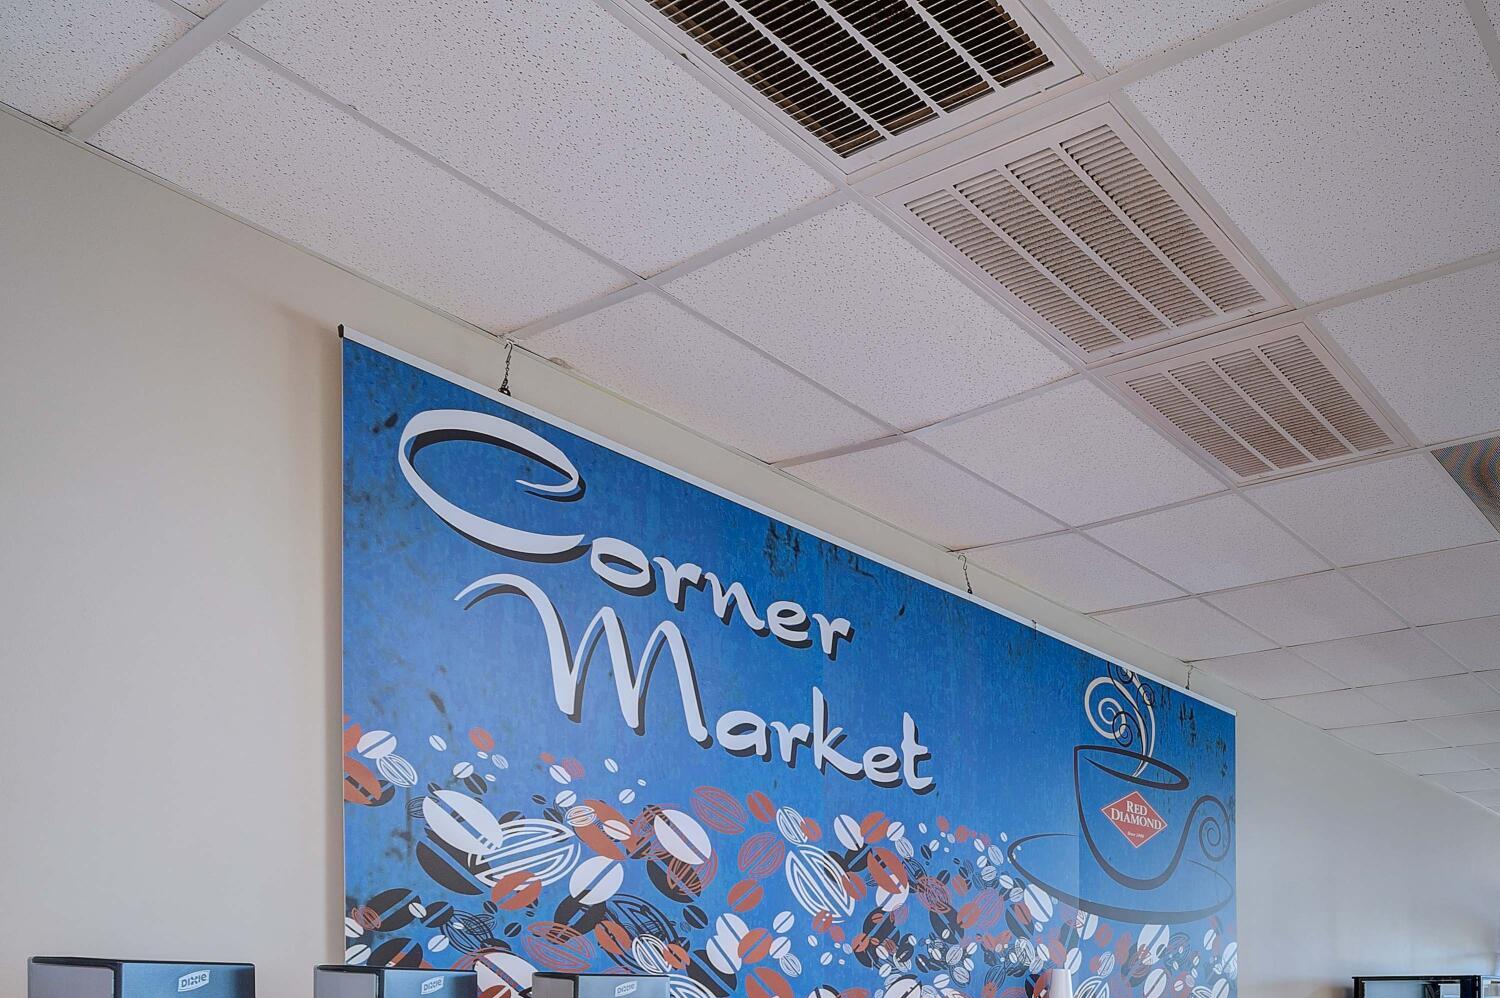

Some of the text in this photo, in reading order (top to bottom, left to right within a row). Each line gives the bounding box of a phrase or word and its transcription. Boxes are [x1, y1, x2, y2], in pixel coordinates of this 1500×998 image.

[398, 409, 853, 660] Corner
[454, 573, 936, 793] Market
[1111, 808, 1162, 830] DIAMOND
[1126, 800, 1148, 817] RED
